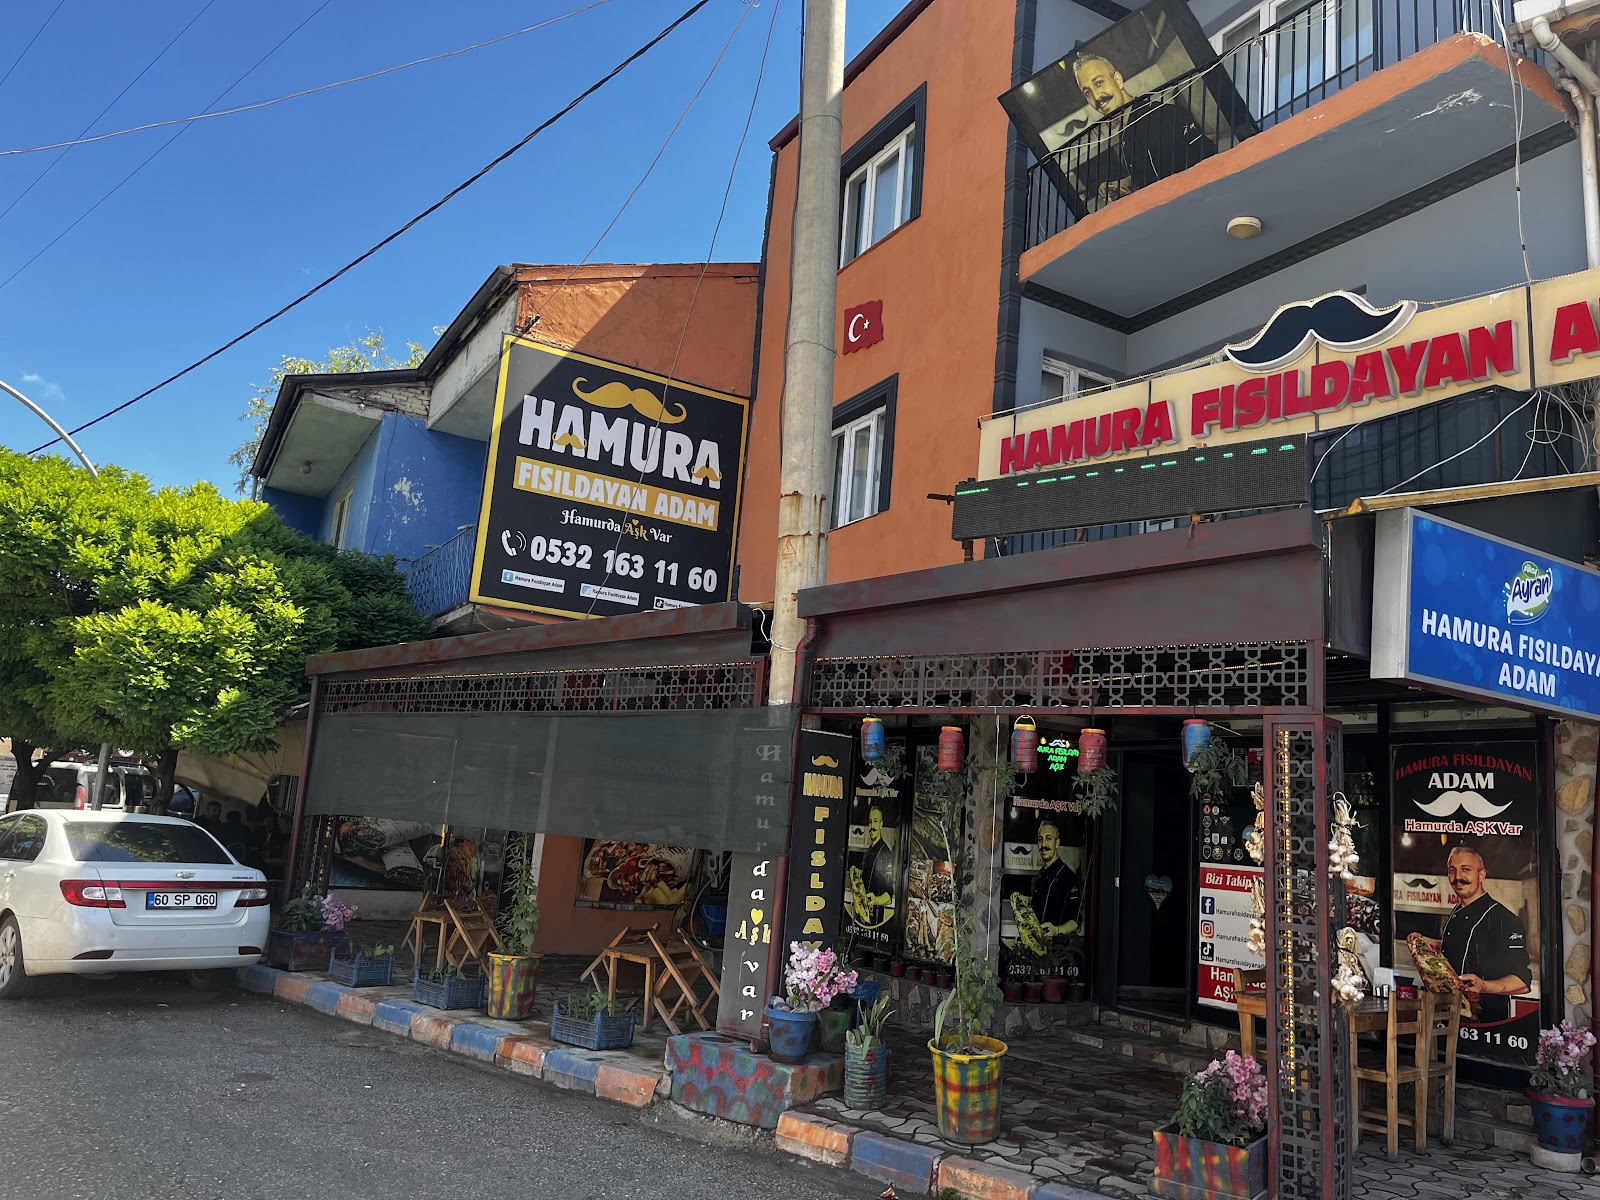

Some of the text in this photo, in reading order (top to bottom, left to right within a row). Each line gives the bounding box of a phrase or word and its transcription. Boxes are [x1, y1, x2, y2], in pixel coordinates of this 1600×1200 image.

[1000, 298, 1600, 477] HAMURA FISILDAYAN A
[519, 395, 722, 489] HAMURA
[518, 461, 716, 527] FISILDAYAN ADAM
[560, 509, 673, 543] Hamurda Aşk Var
[530, 535, 718, 592] 0532 163 11 60
[1512, 576, 1550, 603] Ayran
[1422, 608, 1513, 656] HAMURA
[1499, 663, 1556, 697] ADAM
[1395, 753, 1533, 781] HAMURA FISILDAYAN
[1428, 772, 1495, 789] ADAM
[1404, 819, 1523, 837] Hamurda AŞK Var
[1205, 872, 1252, 890] Bizi Takip
[154, 894, 168, 905] 60
[174, 894, 190, 905] SP
[195, 894, 215, 905] 060
[1447, 893, 1461, 904] ADA
[1460, 1027, 1528, 1050] 63 11 60
